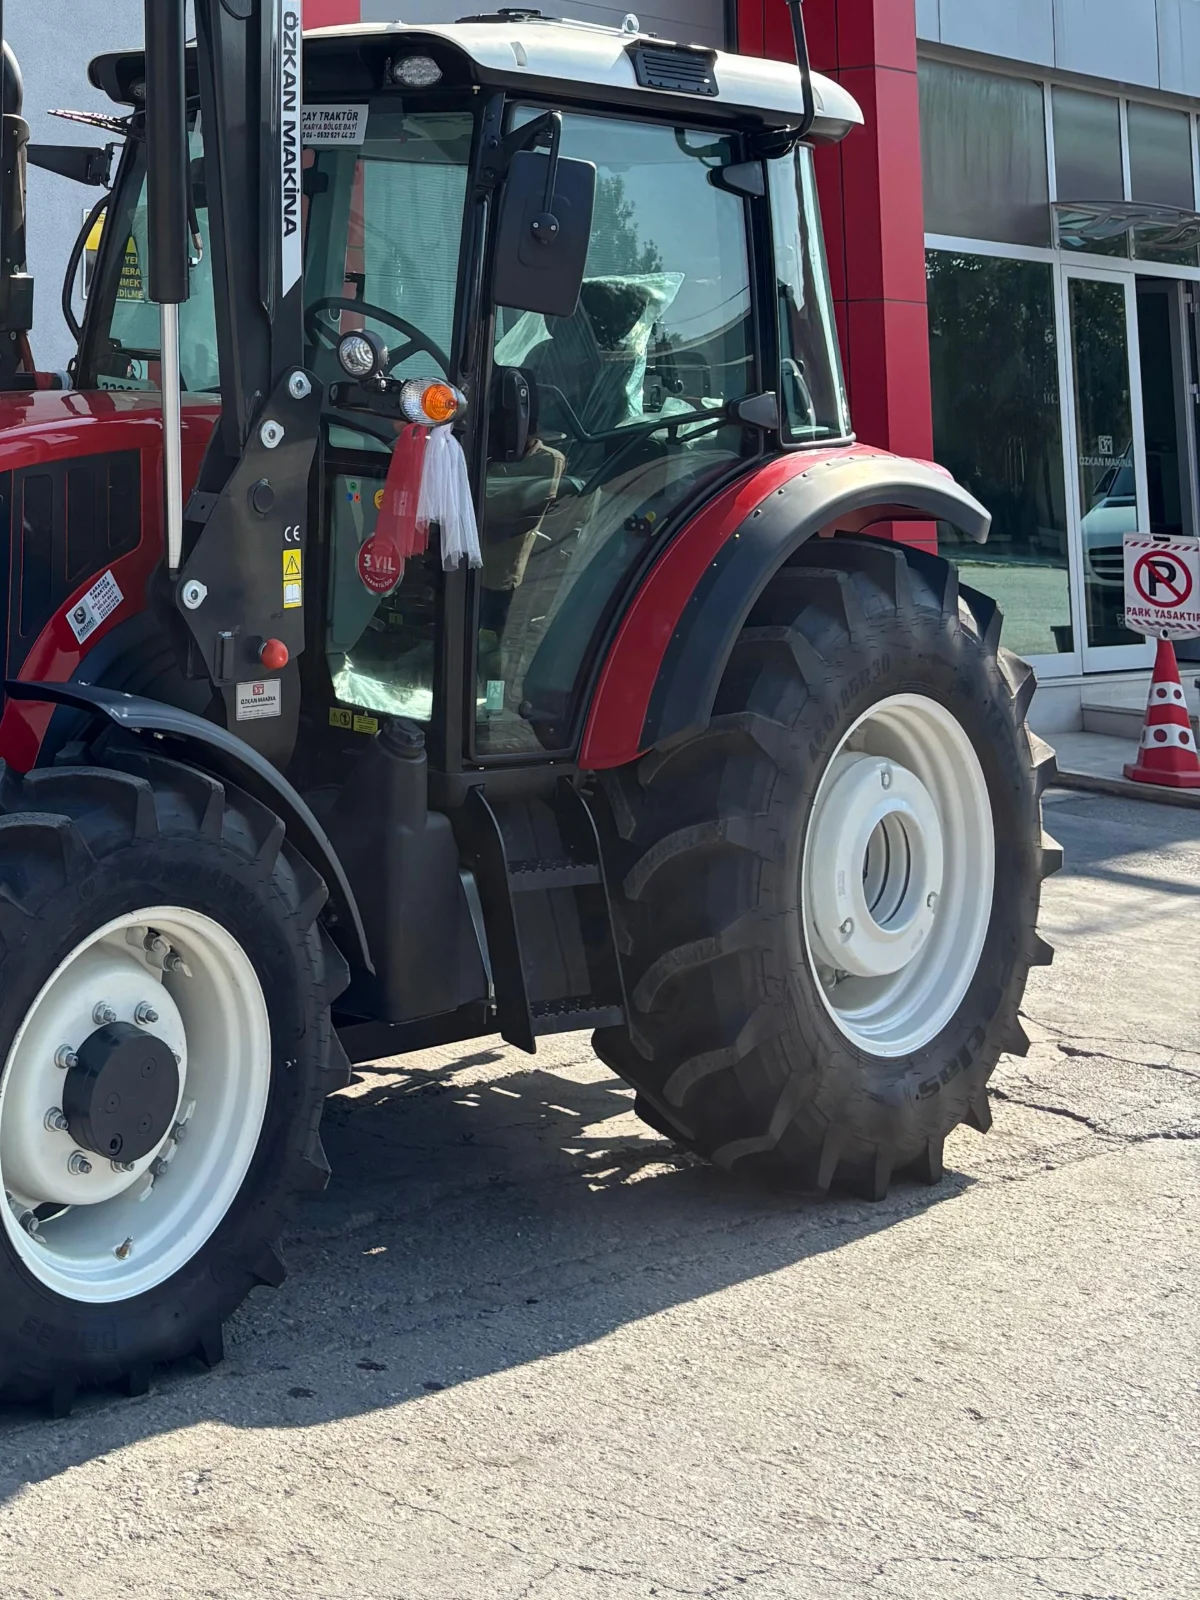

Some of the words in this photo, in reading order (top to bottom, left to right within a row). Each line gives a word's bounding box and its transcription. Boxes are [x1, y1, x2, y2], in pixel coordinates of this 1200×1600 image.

[283, 11, 299, 112] ÖZKAN
[319, 109, 358, 121] TRAKTÖR
[303, 123, 322, 131] KARYA
[323, 122, 342, 131] BÖLGE
[283, 120, 300, 238] MAKİNA
[284, 525, 300, 542] CE
[363, 554, 371, 567] 3
[374, 555, 396, 571] YIL
[1126, 607, 1151, 617] PARK
